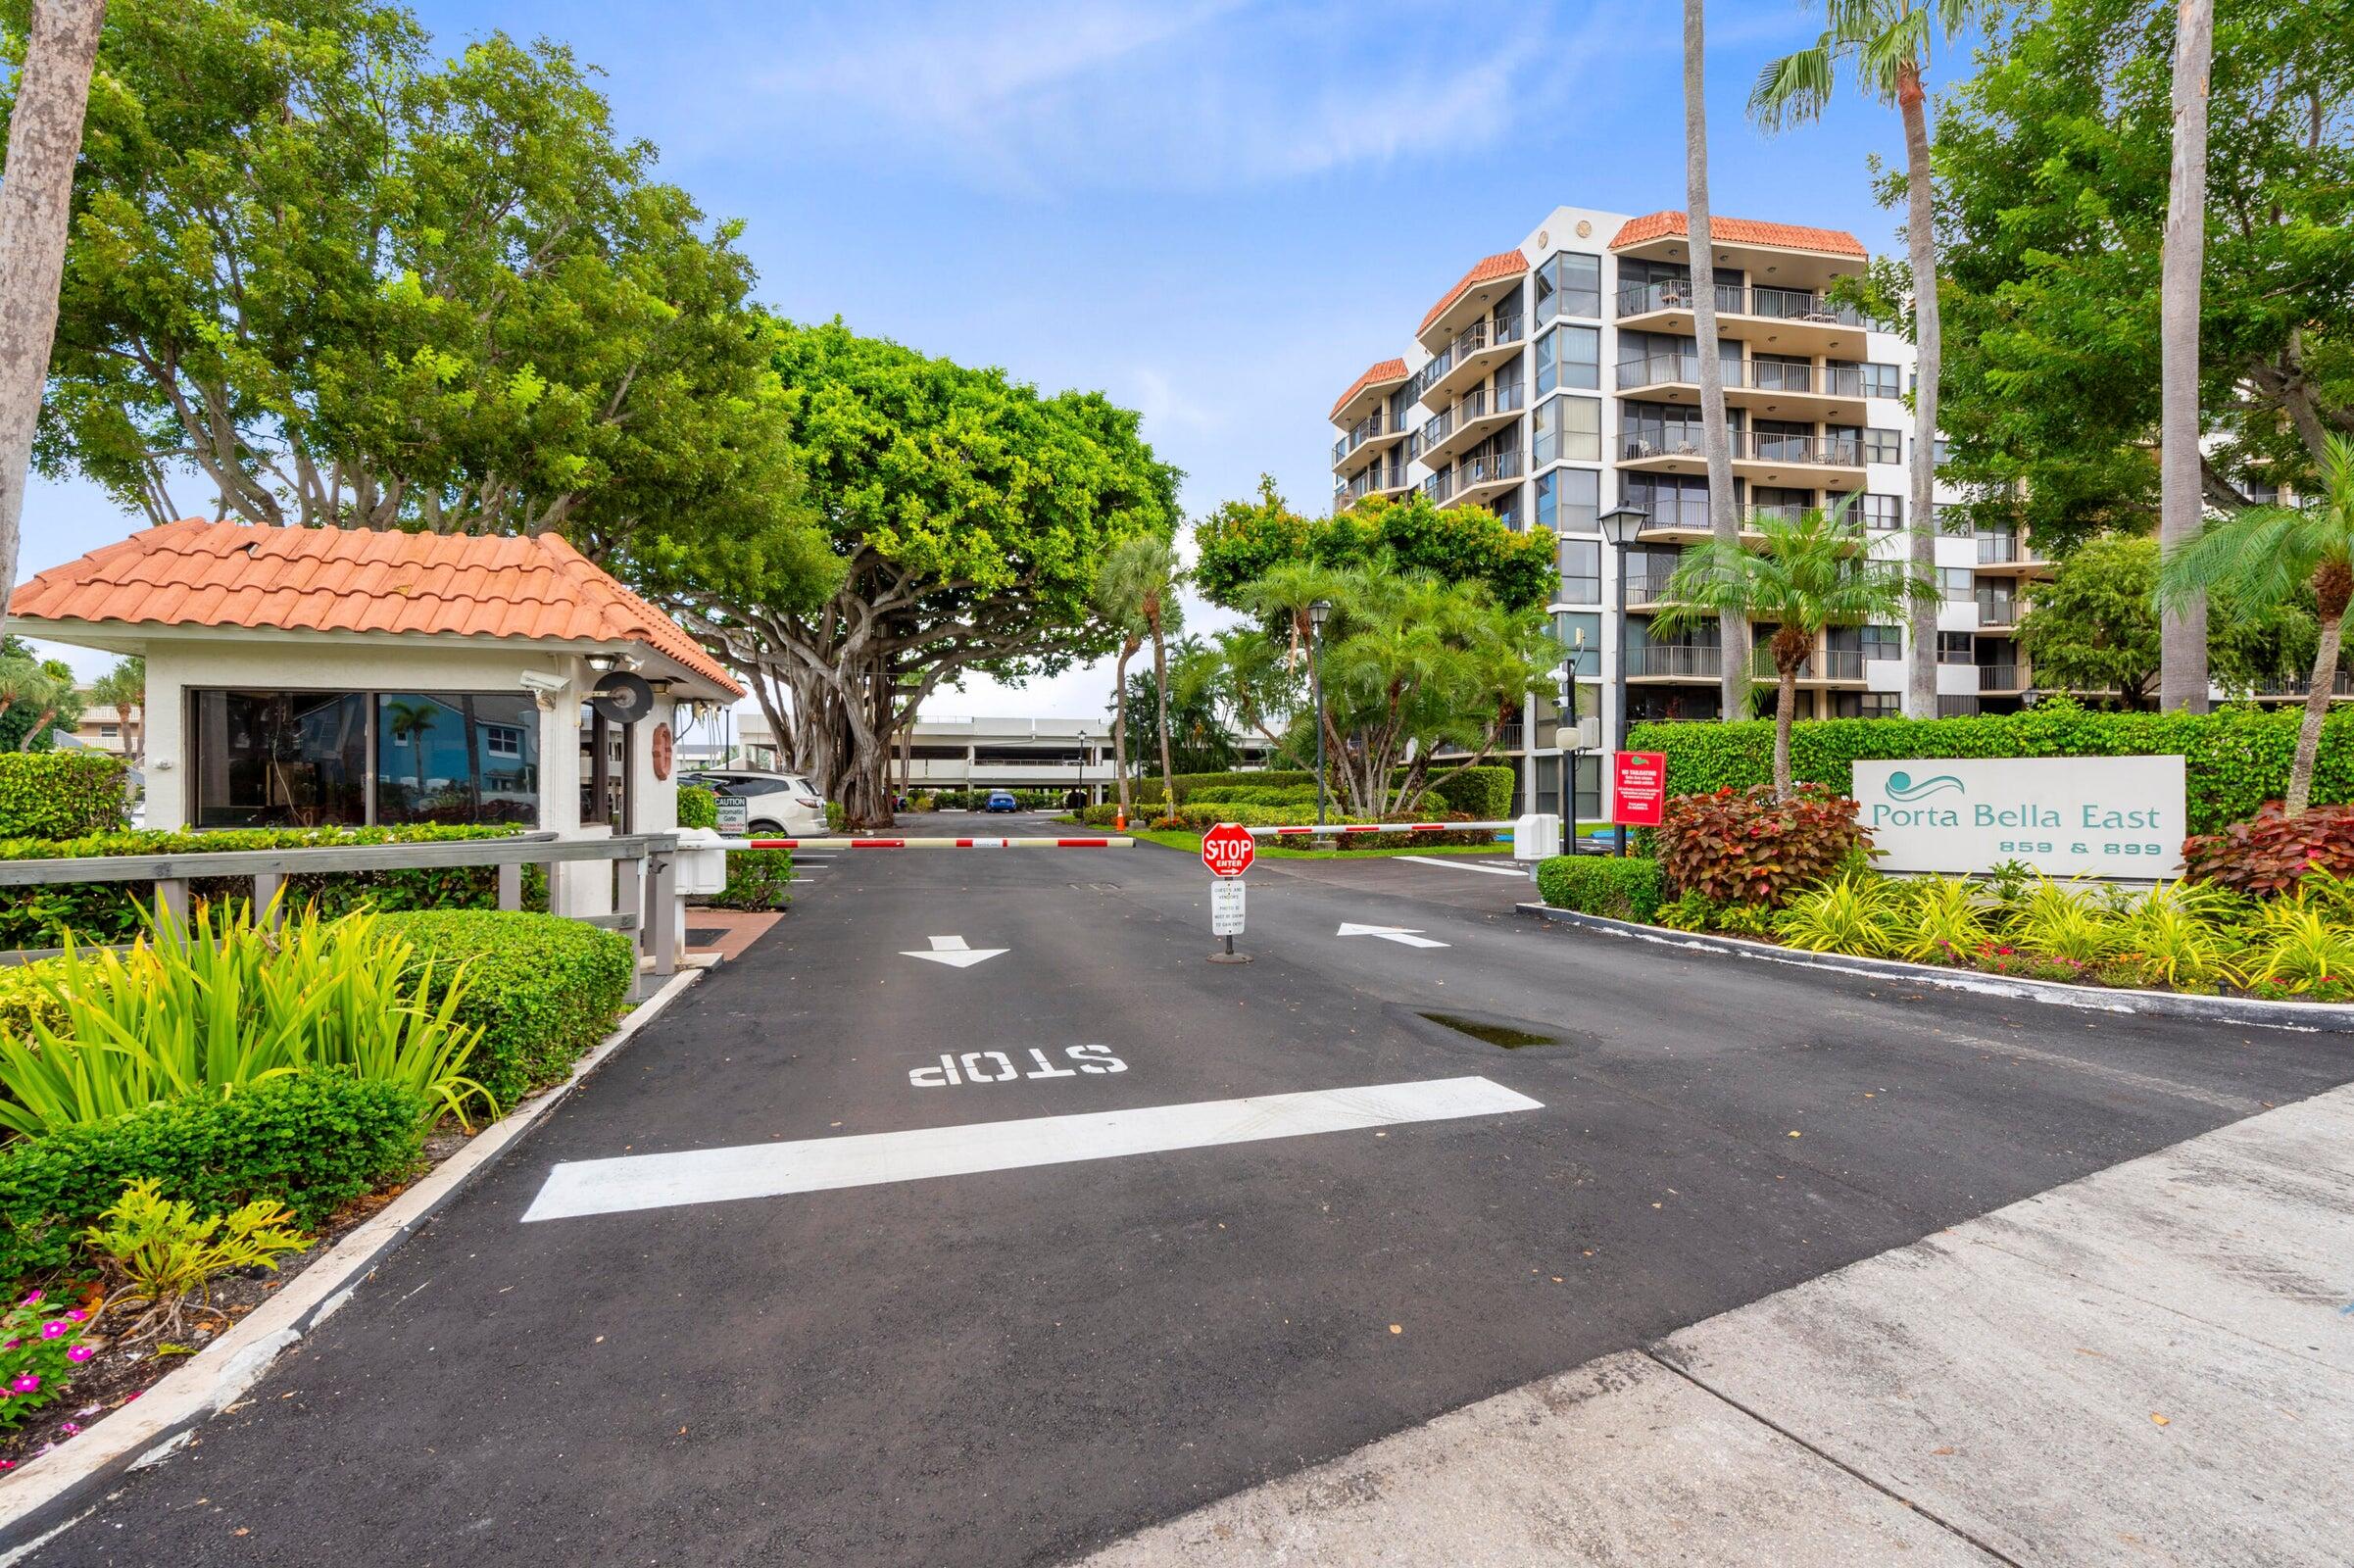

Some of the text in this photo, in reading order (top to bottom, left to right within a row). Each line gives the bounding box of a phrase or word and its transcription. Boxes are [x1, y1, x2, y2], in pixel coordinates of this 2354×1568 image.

[1873, 804, 2162, 829] Porta Bella East
[1205, 839, 1252, 860] STOP
[1999, 841, 2162, 855] 859 & 899
[908, 1045, 1128, 1087] STOP
